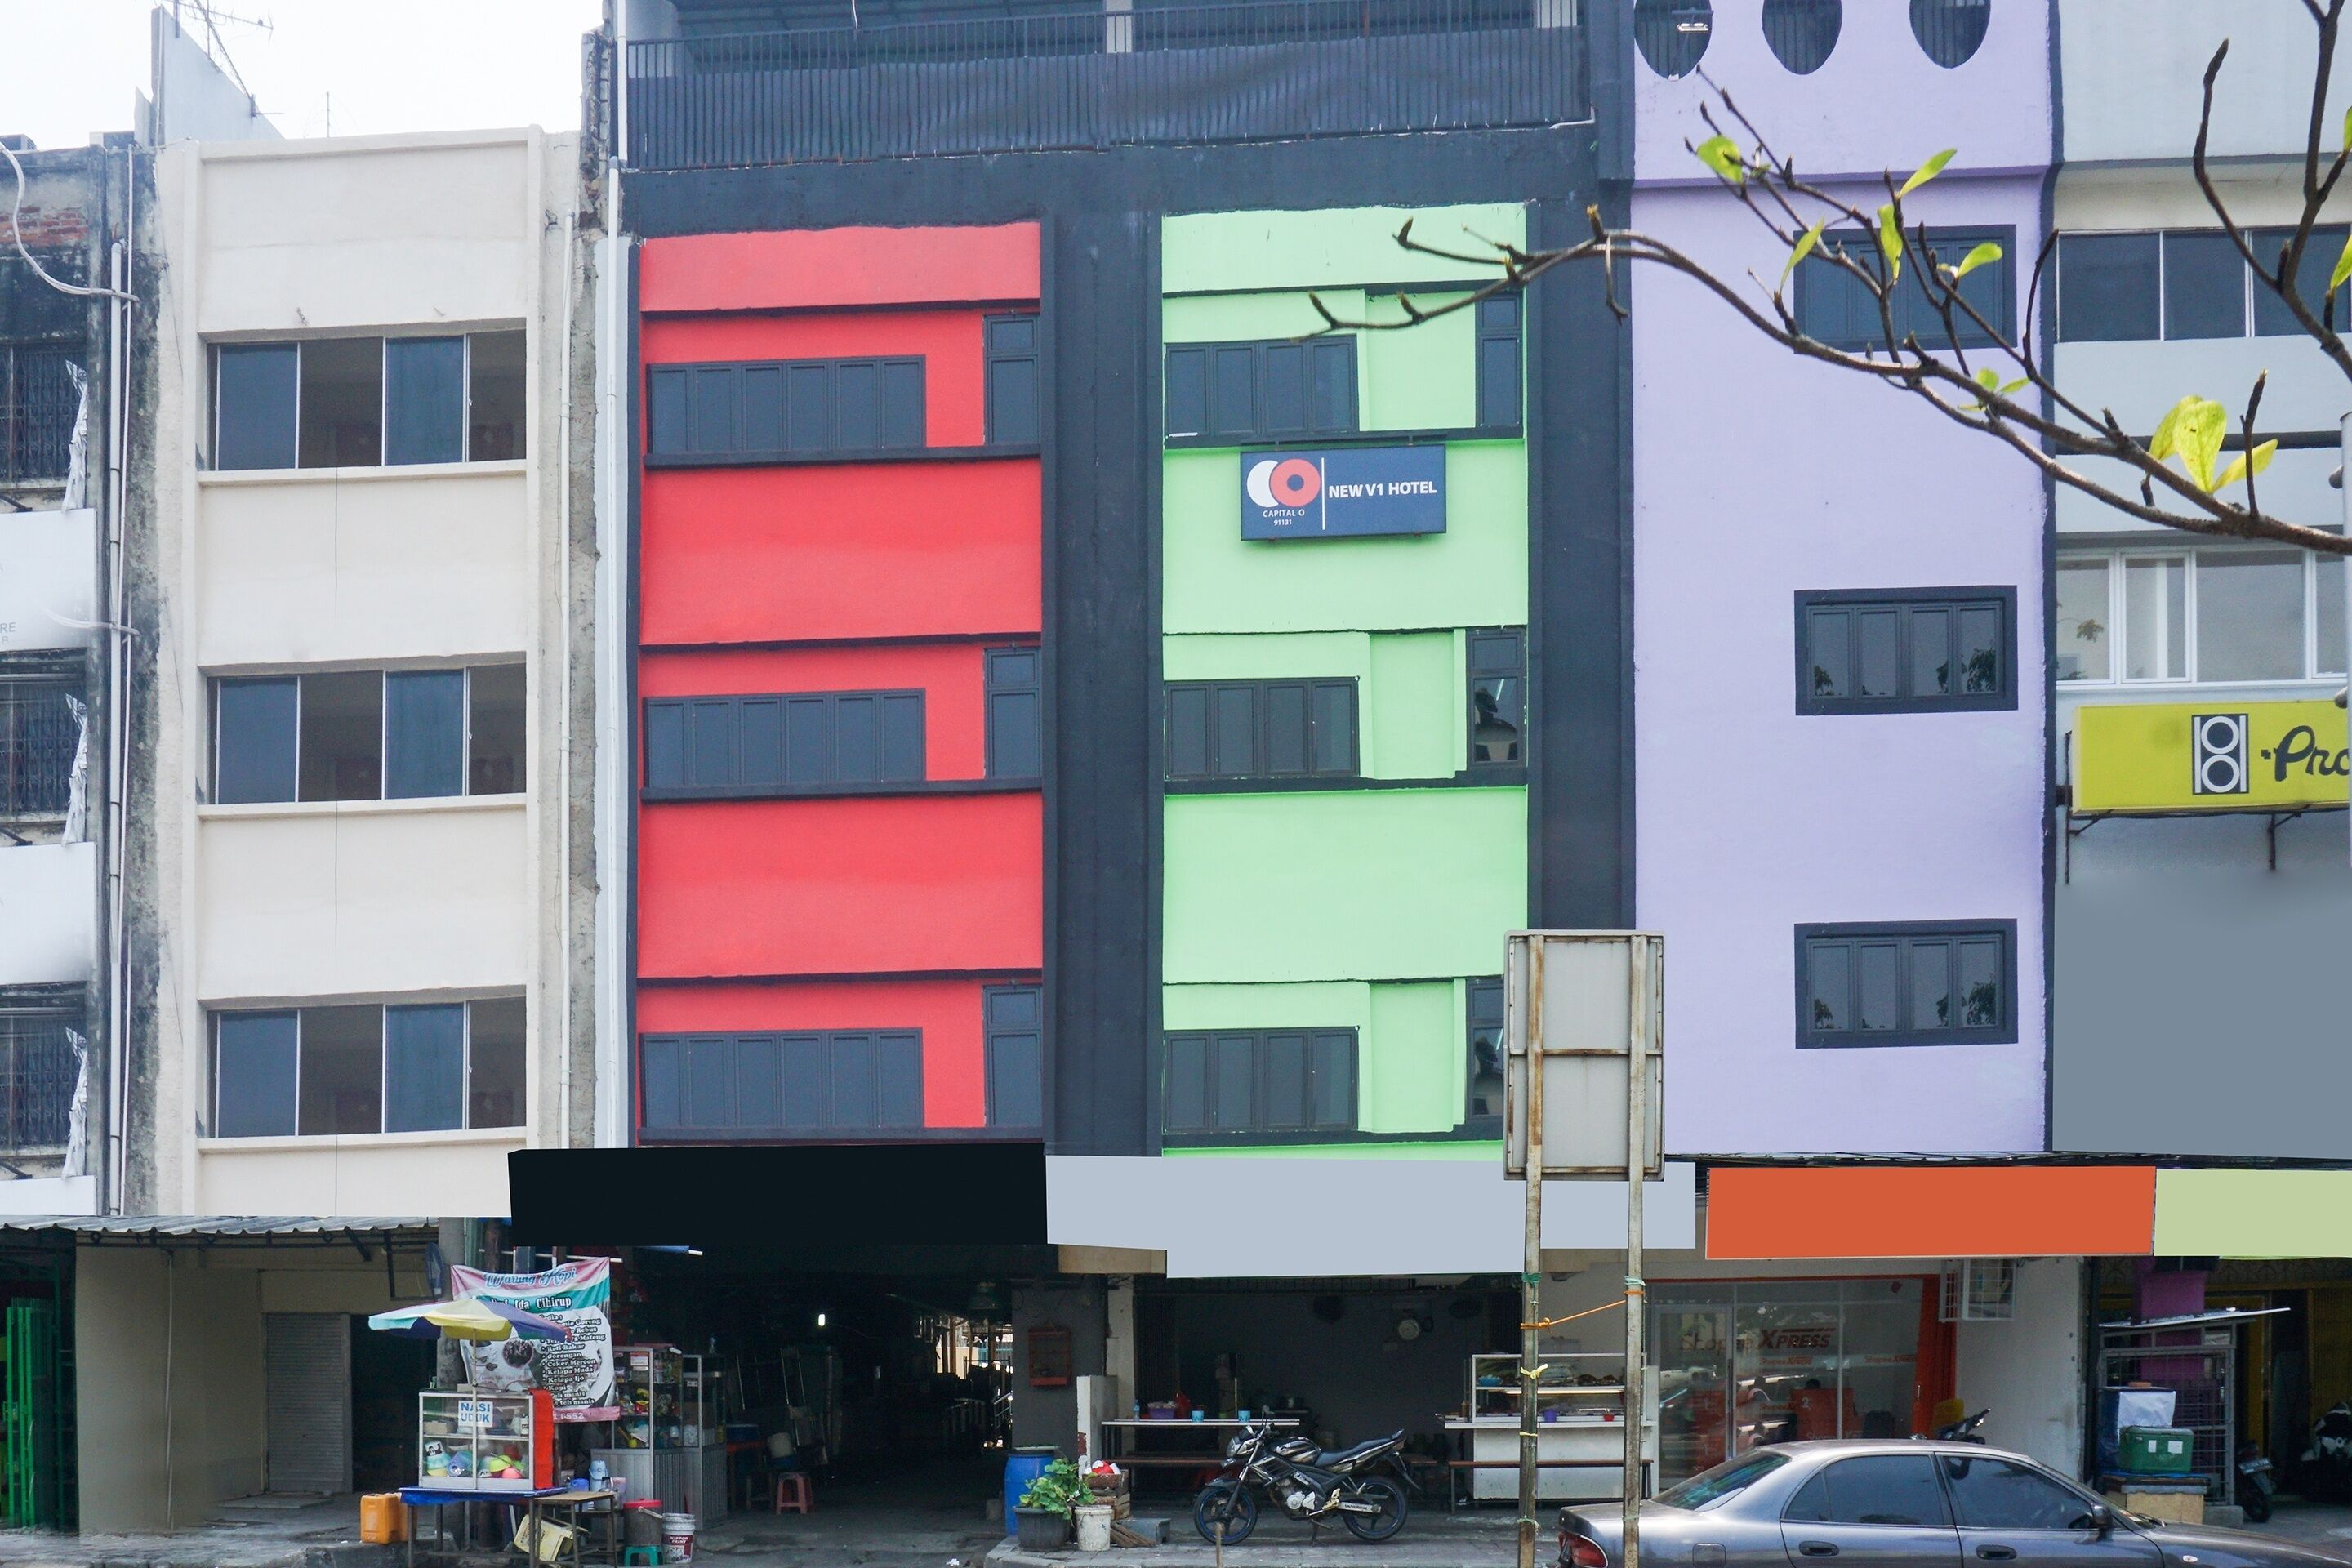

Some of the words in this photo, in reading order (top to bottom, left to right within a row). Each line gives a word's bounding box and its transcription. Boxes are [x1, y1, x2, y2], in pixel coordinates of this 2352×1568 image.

[1329, 484, 1363, 498] NEW
[1365, 483, 1383, 496] V1
[1388, 481, 1437, 496] HOTEL
[1263, 510, 1296, 518] CAPITAL
[483, 1273, 536, 1288] Warung
[540, 1267, 577, 1286] Kopi
[536, 1297, 572, 1309] Cihirup
[1758, 1329, 1832, 1348] XPRESS
[461, 1402, 490, 1412] NASI
[1802, 1397, 1810, 1408] 2
